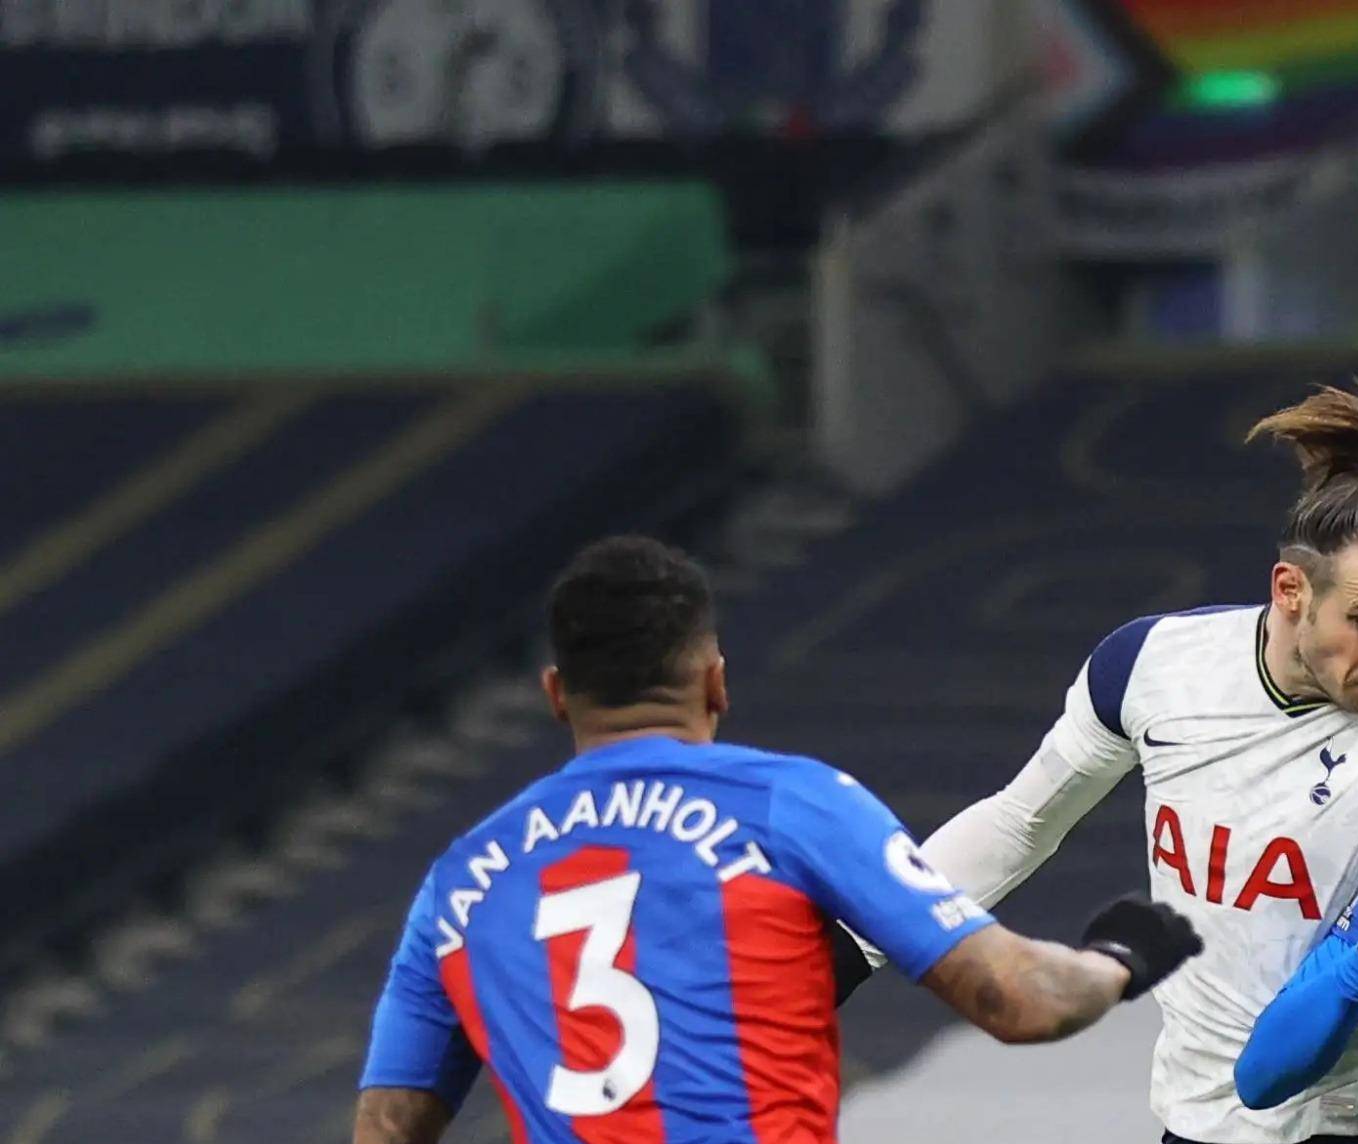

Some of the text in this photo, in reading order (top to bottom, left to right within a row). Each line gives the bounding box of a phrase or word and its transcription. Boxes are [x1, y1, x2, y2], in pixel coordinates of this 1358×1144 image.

[436, 780, 773, 958] VAN AANHOLT
[1153, 804, 1322, 920] AIA
[534, 871, 660, 1116] 3
